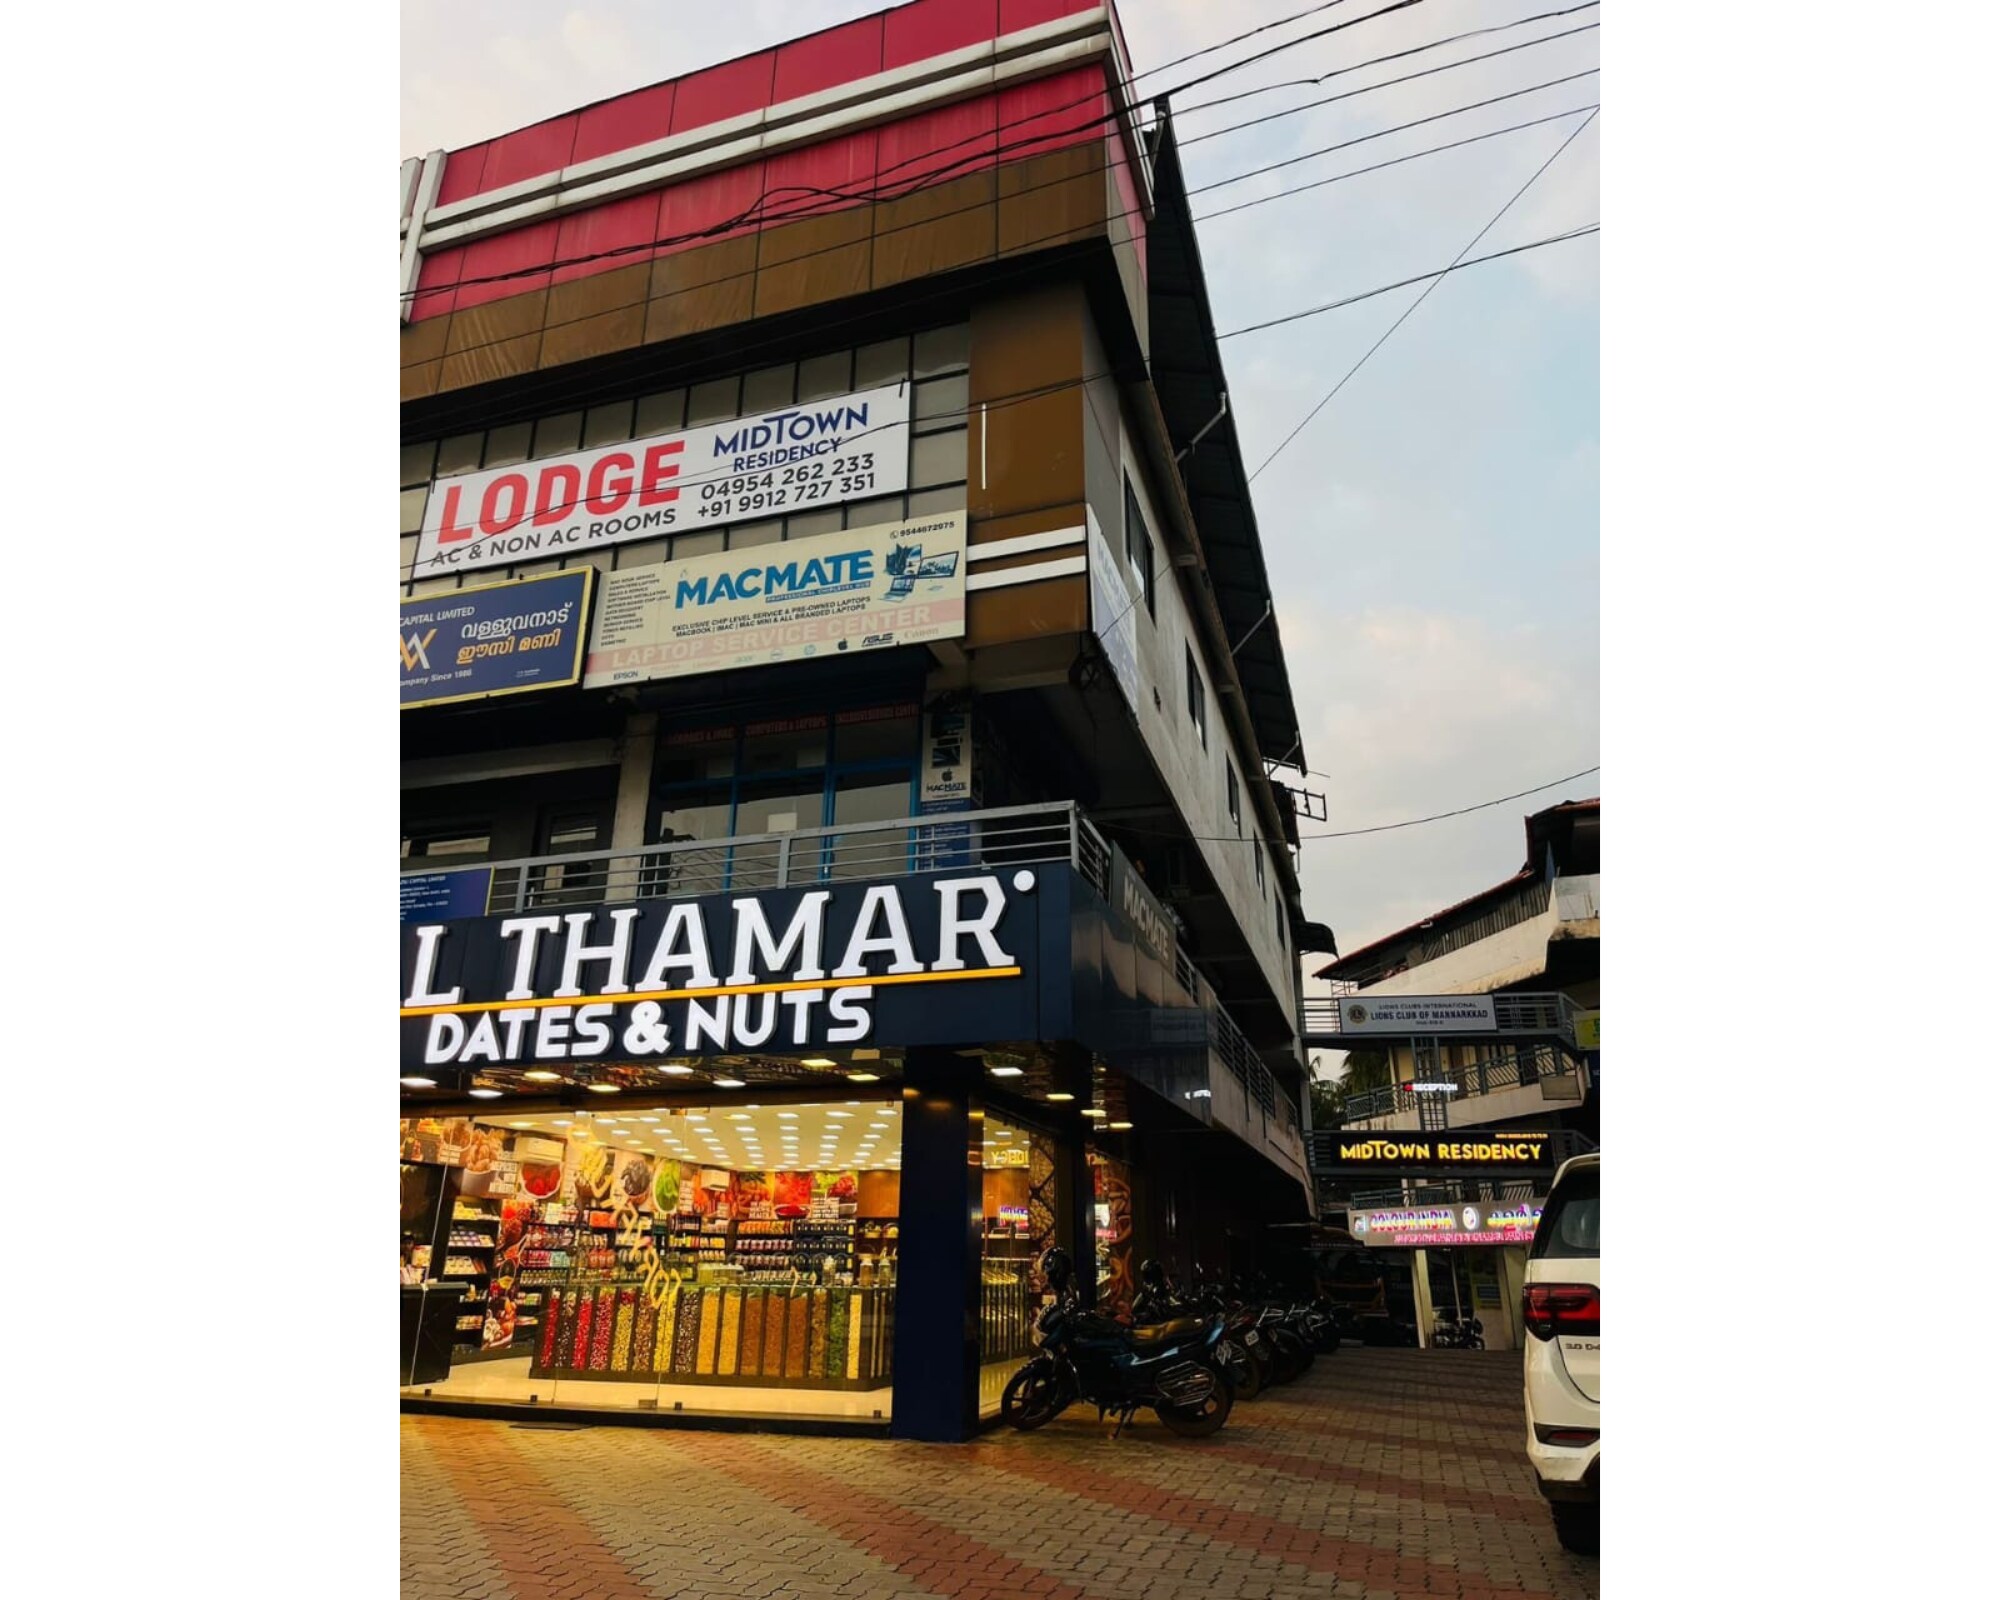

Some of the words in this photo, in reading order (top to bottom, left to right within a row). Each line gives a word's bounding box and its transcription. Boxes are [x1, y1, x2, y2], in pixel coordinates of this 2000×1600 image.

[713, 402, 869, 458] MIDTOWN
[701, 472, 774, 500] 04954
[781, 463, 825, 486] 262
[831, 453, 875, 476] 233
[733, 436, 842, 473] RESIDENCY
[437, 440, 686, 544] LODGE
[698, 499, 732, 518] +91
[738, 490, 787, 513] 9912
[794, 480, 833, 502] 727
[840, 472, 876, 494] 351
[430, 549, 462, 568] AC
[468, 544, 483, 560] &
[490, 533, 542, 558] NON
[547, 525, 581, 546] AC
[588, 508, 677, 539] ROOMS
[675, 550, 874, 609] MACMATE
[400, 612, 435, 628] CAPITAL
[436, 606, 476, 621] LIMITED
[612, 640, 703, 667] LAPTOP
[713, 623, 818, 652] SERVICE
[826, 606, 931, 635] CENTER
[672, 620, 711, 632] EXCLUSIVE
[711, 616, 729, 626] CHIP
[729, 613, 751, 624] LEVEL
[752, 609, 783, 621] SERVICE
[791, 601, 836, 614] PRE-OWNED
[837, 595, 871, 608] LAPTOPS
[675, 626, 713, 638] MACBOOK
[739, 619, 756, 629] MAC
[757, 617, 772, 626] MINI
[779, 613, 794, 622] ALL
[795, 607, 831, 620] BRANDED
[832, 602, 866, 615] LAPTOPS
[518, 628, 562, 652] മണി
[430, 671, 452, 683] Since
[613, 671, 638, 680] EPSON
[501, 875, 1015, 1001] THAMAR
[1124, 875, 1169, 960] MACMATE
[425, 1003, 617, 1064] DATES
[623, 1001, 671, 1056] &
[685, 985, 873, 1051] NUTS
[1370, 1011, 1395, 1021] LIONS
[1396, 1011, 1417, 1020] CLUB
[1419, 1010, 1430, 1019] OF
[1340, 1140, 1430, 1160] MIDTOWN
[1437, 1143, 1542, 1161] RESIDENCY
